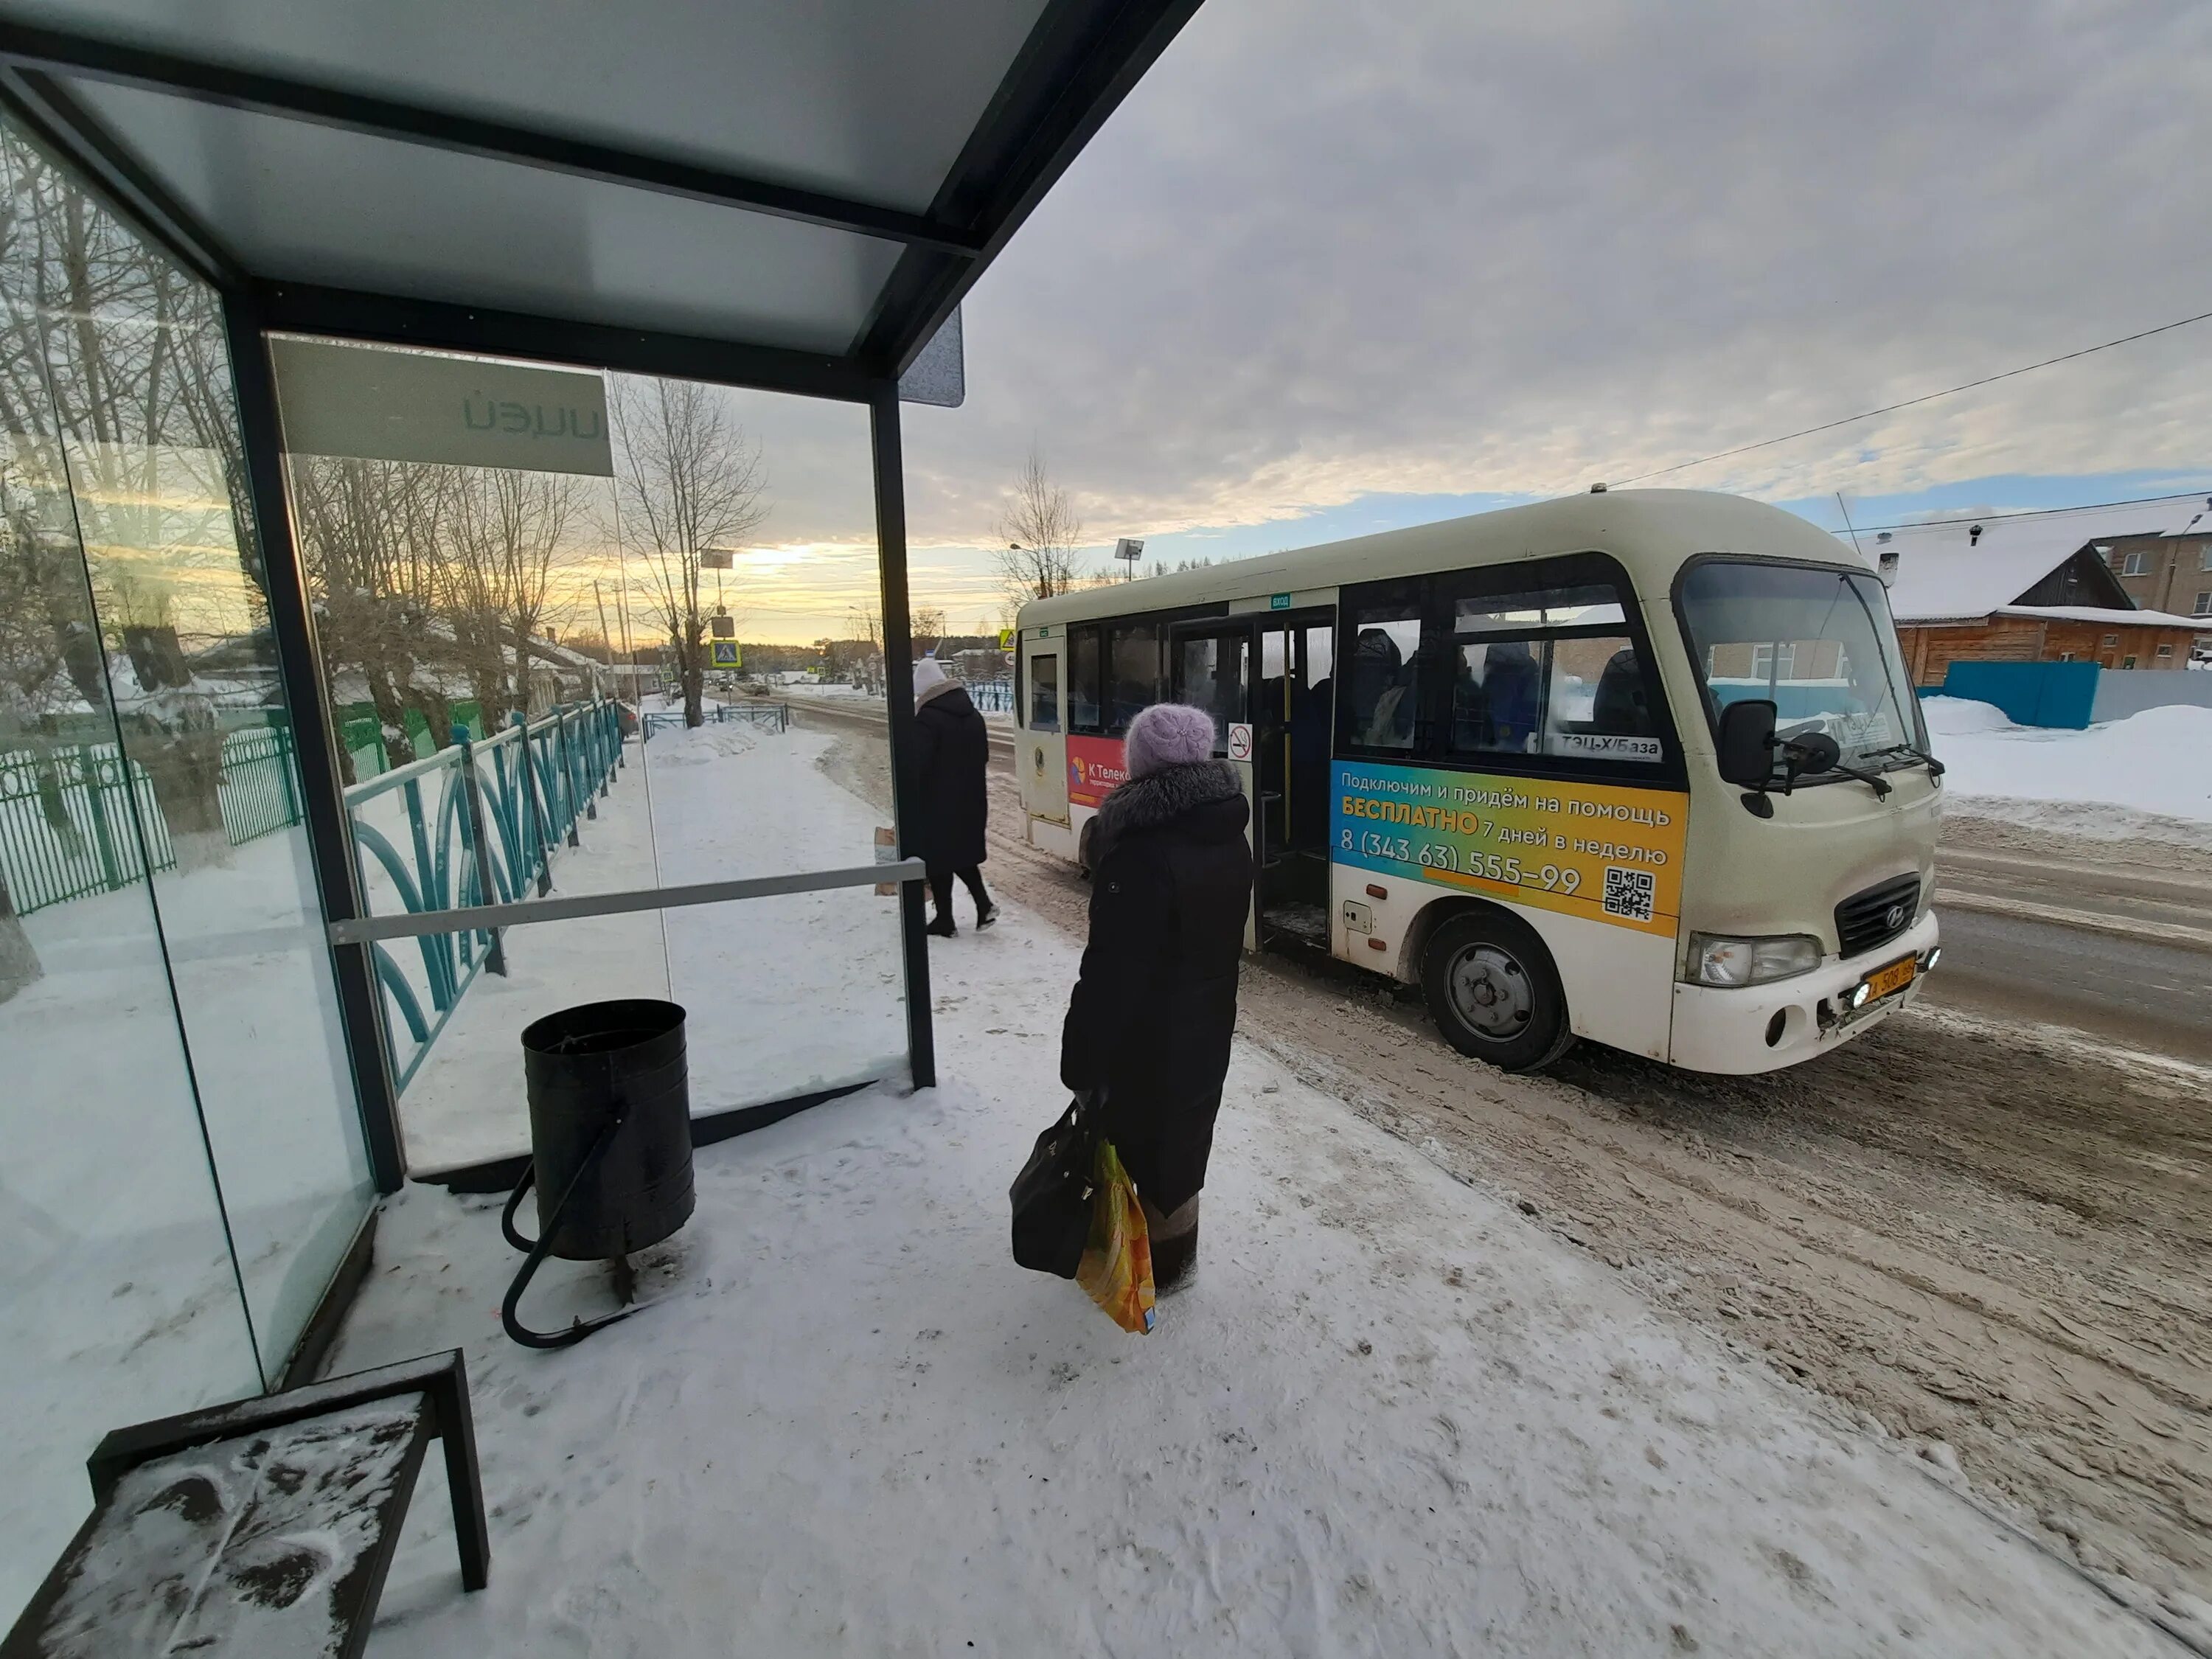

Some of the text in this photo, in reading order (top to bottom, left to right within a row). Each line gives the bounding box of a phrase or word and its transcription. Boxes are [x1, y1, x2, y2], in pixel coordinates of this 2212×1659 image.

[1088, 763, 1132, 782] К Телеко
[1341, 773, 1670, 827] Подключим и придём на помощь
[1341, 829, 1353, 850] 8
[1360, 831, 1411, 863] (343
[1419, 844, 1459, 872] 63)
[1342, 796, 1667, 865] БЕСПЛАТНО 7 дней в неделю
